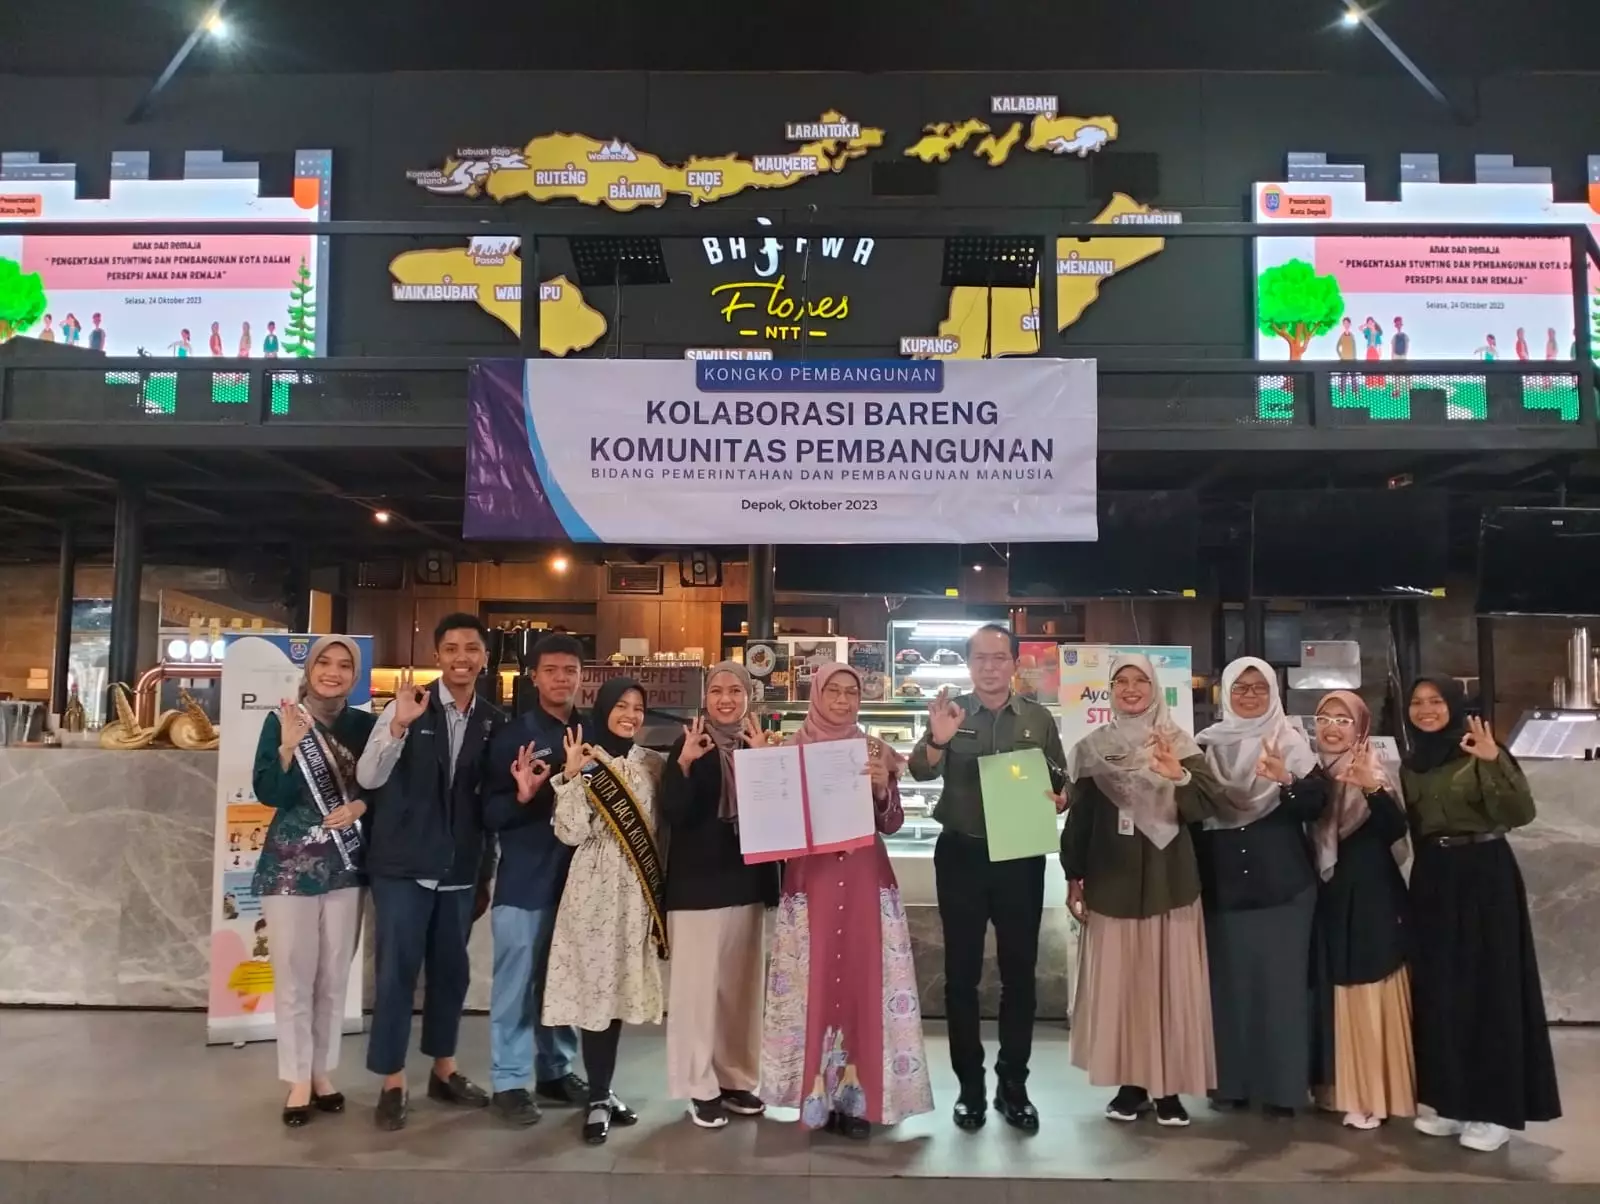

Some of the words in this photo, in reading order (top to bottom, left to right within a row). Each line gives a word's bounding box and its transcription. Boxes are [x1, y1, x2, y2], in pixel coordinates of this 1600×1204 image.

[993, 98, 1056, 111] KALABAHI
[457, 148, 489, 156] Labuan
[491, 148, 510, 157] Bajo
[754, 157, 817, 170] MAUMERE
[406, 171, 442, 179] Komodo
[536, 171, 586, 184] RUTENG
[688, 172, 721, 185] ENDE
[609, 185, 662, 198] BAJAWA
[51, 257, 109, 265] PENGENTASAN
[112, 257, 152, 265] STUNTING
[174, 256, 236, 264] PEMBANGUNAN
[239, 256, 261, 264] KOTA
[263, 256, 290, 264] DALAM
[1346, 260, 1406, 268] PENGENTASAN
[1409, 260, 1451, 268] STUNTING
[1453, 261, 1470, 269] DAN
[1473, 261, 1537, 269] PEMBANGUNAN
[1540, 262, 1561, 270] KOTA
[107, 272, 143, 280] PERSEPSI
[146, 272, 168, 280] ANAK
[171, 272, 187, 280] DAN
[1405, 275, 1443, 284] PERSEPSI
[1446, 276, 1469, 284] ANAK
[1471, 276, 1487, 284] DAN
[393, 285, 478, 299] WAIKABUBAK
[766, 326, 800, 339] NTT
[901, 339, 952, 353] KUPANG
[704, 368, 783, 381] KONGKO
[790, 368, 936, 381] PEMBANGUNAN
[646, 400, 854, 426] KOLABORASI
[864, 401, 998, 425] BARENG
[590, 437, 787, 463] KOMUNITAS
[796, 438, 1053, 464] PEMBANGUNAN
[591, 468, 655, 479] BIDANG
[662, 469, 793, 480] PEMERINTAHAN
[801, 470, 834, 480] DAN
[841, 470, 969, 480] PEMBANGUNAN
[977, 469, 1053, 480] MANUSIA
[741, 500, 786, 512] Depok,
[789, 499, 843, 511] Oktober
[845, 499, 878, 511] 2023
[301, 736, 328, 778] FAVORITE
[317, 773, 339, 799] DUTA
[592, 770, 620, 802] DUTA
[611, 798, 637, 831] BACA
[628, 826, 650, 858] KOTA
